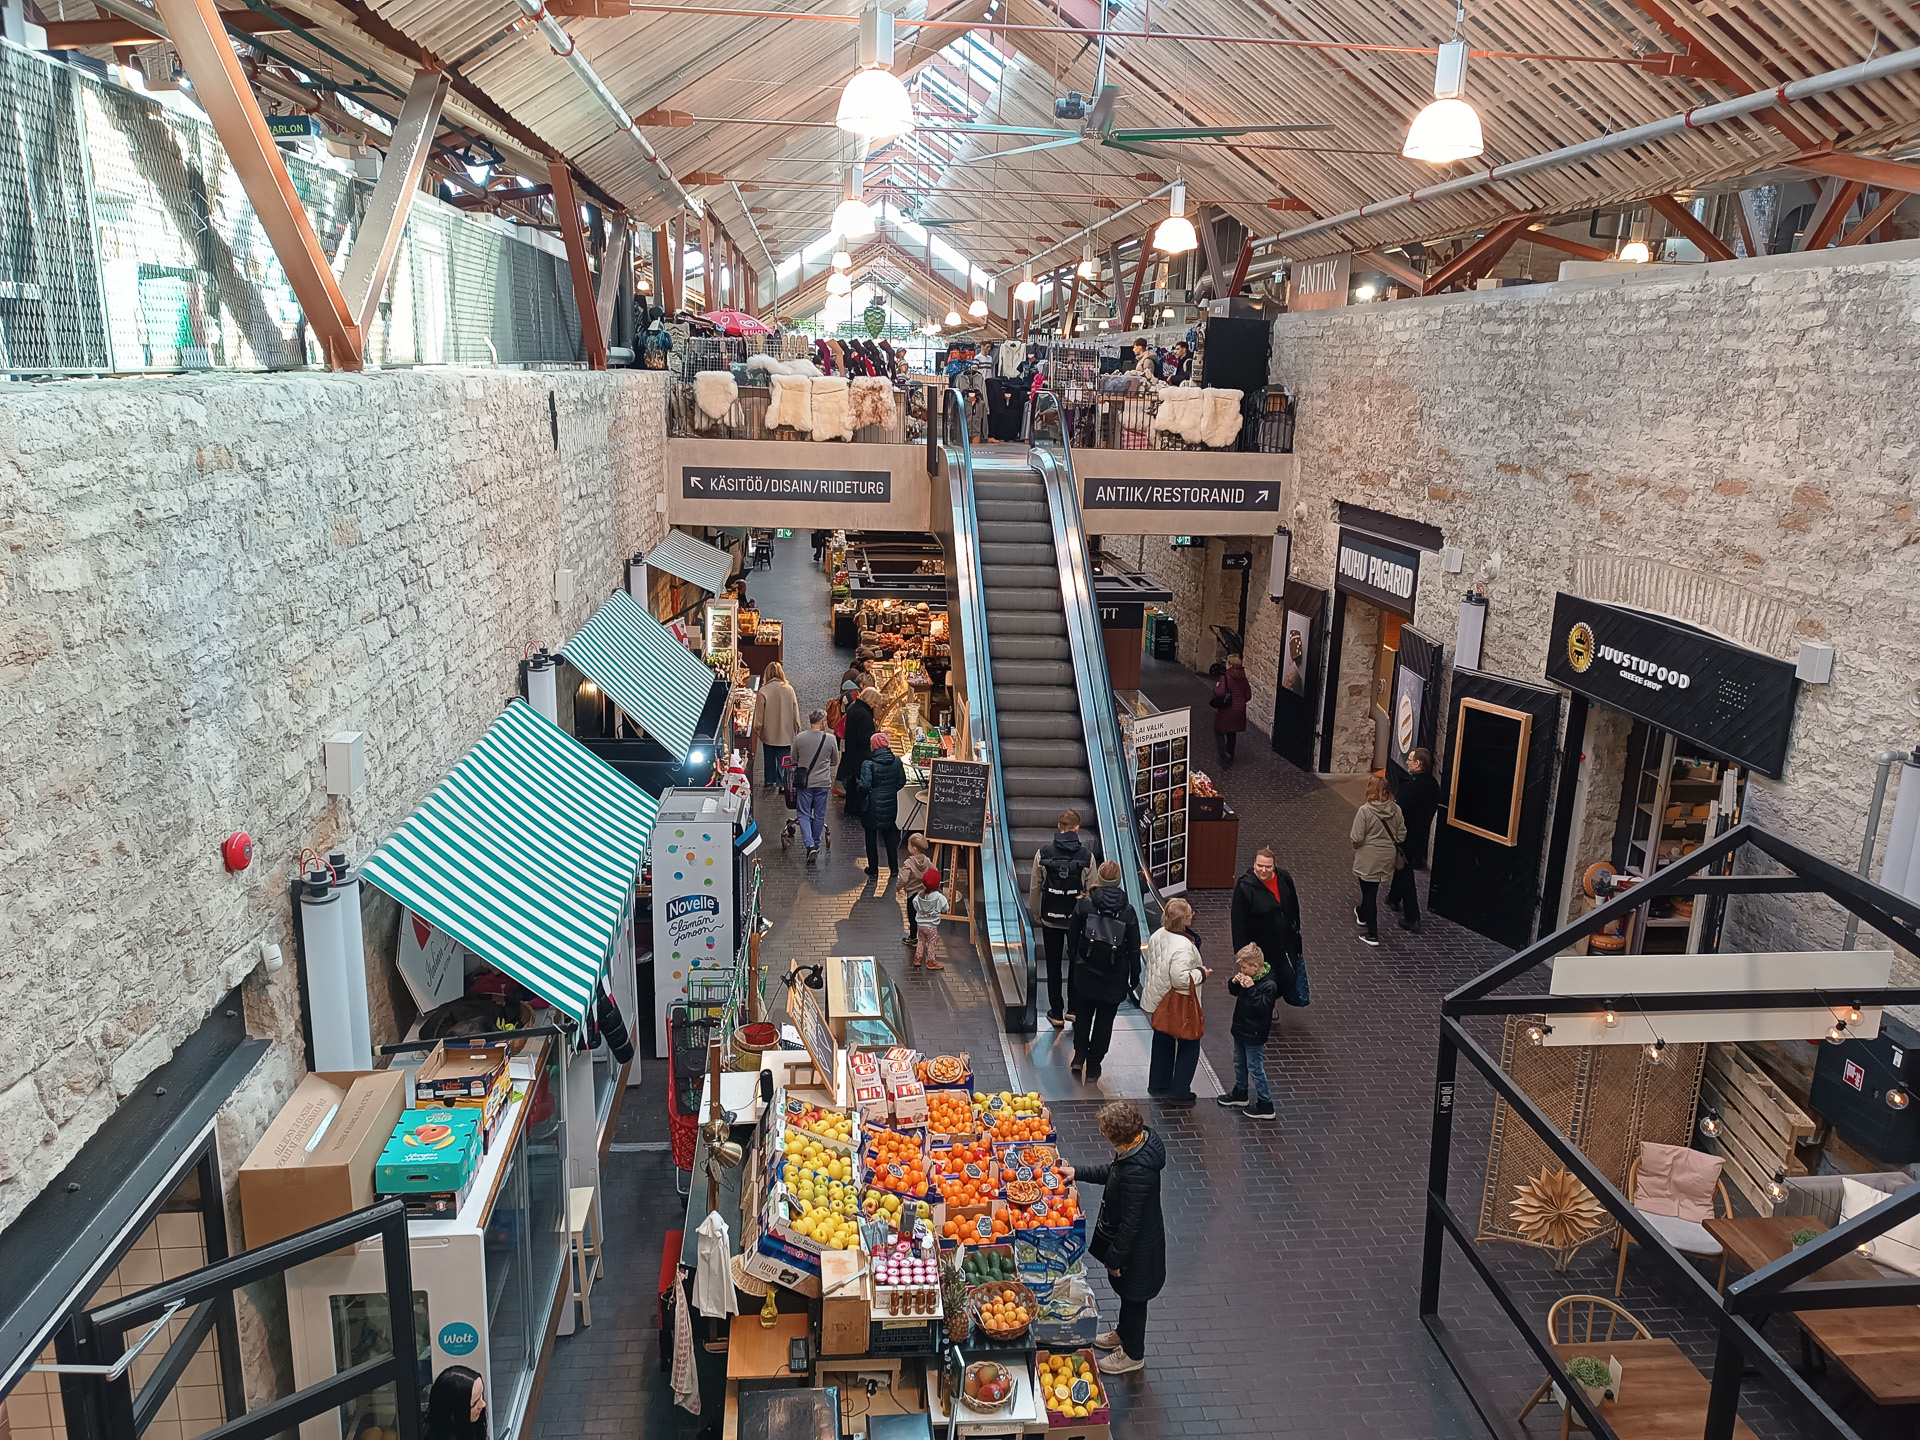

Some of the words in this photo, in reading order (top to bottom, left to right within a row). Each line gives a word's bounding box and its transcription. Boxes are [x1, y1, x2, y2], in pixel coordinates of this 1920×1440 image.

[1298, 259, 1338, 296] ANTIIK
[710, 475, 884, 494] KÄSITÖÖ/DISAIN/RIIDETURG
[1095, 486, 1245, 504] ANTIIK/RESTORANID
[1339, 546, 1369, 582] MUHU
[1368, 556, 1414, 599] PAGARID
[1099, 607, 1119, 620] TT
[1597, 644, 1691, 689] JUUSTUPOOD
[1619, 669, 1644, 685] CHEESE
[1643, 679, 1663, 692] SHOP
[1135, 726, 1146, 735] LAI
[1146, 722, 1165, 732] VALIK
[1135, 732, 1168, 744] HISPAANIA
[669, 895, 715, 919] Novelle
[668, 915, 715, 937] Elämän
[673, 924, 724, 947] janoon
[298, 1102, 314, 1125] FRESCO
[274, 1127, 297, 1156] ASCIUTTO
[443, 1333, 474, 1344] Wolt
